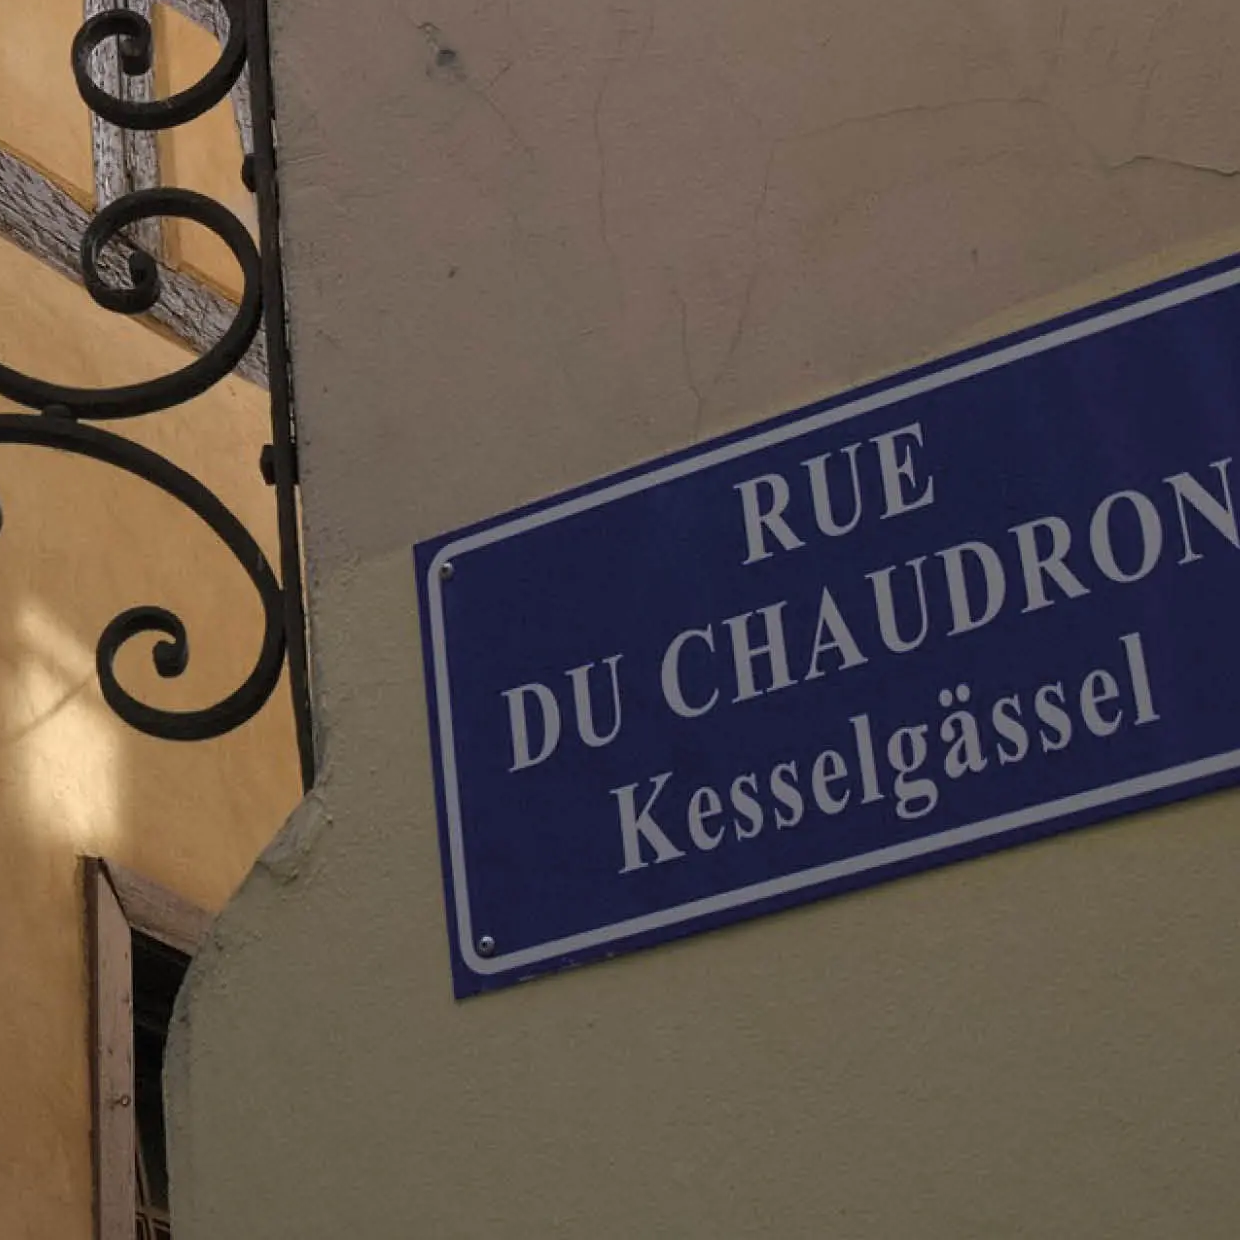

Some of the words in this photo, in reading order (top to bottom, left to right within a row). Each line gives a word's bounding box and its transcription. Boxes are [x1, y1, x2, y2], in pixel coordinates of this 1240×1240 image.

[502, 655, 623, 773] DU
[662, 457, 1240, 718] CHAUDRON
[734, 423, 934, 565] RUE
[610, 632, 1160, 874] Kesselgässel
